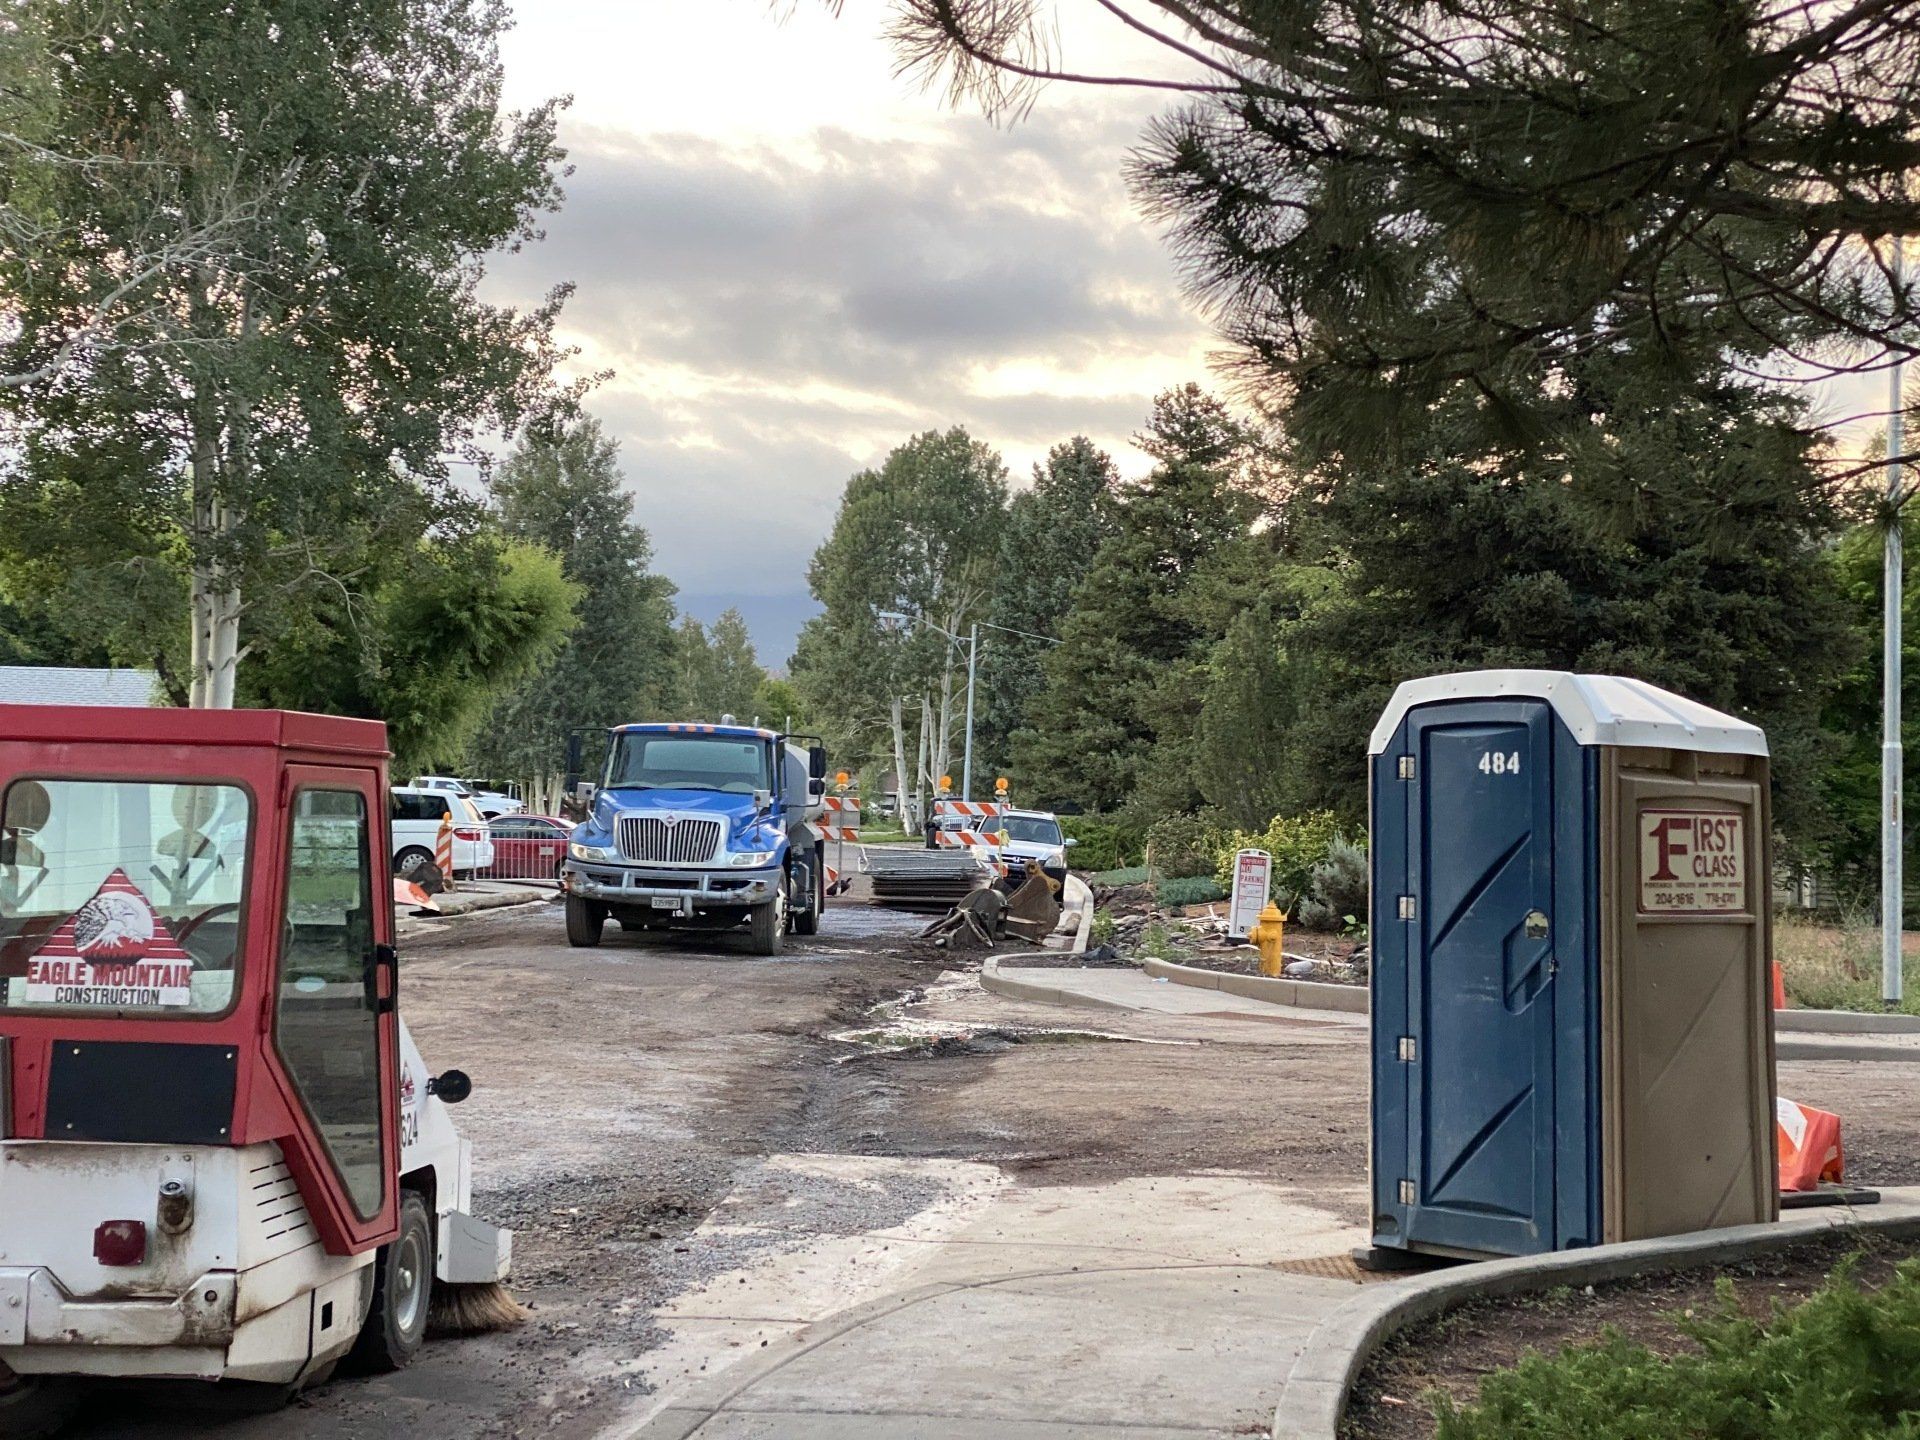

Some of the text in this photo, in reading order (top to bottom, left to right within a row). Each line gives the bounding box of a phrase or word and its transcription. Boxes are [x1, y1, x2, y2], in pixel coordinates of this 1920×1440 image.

[1478, 751, 1520, 775] 484
[1240, 864, 1252, 874] NO
[1693, 854, 1737, 878] CLASS
[1240, 875, 1264, 884] PARKING
[26, 961, 193, 988] EAGLE MOUNTAIN
[55, 986, 161, 1006] CONSTRUCTION
